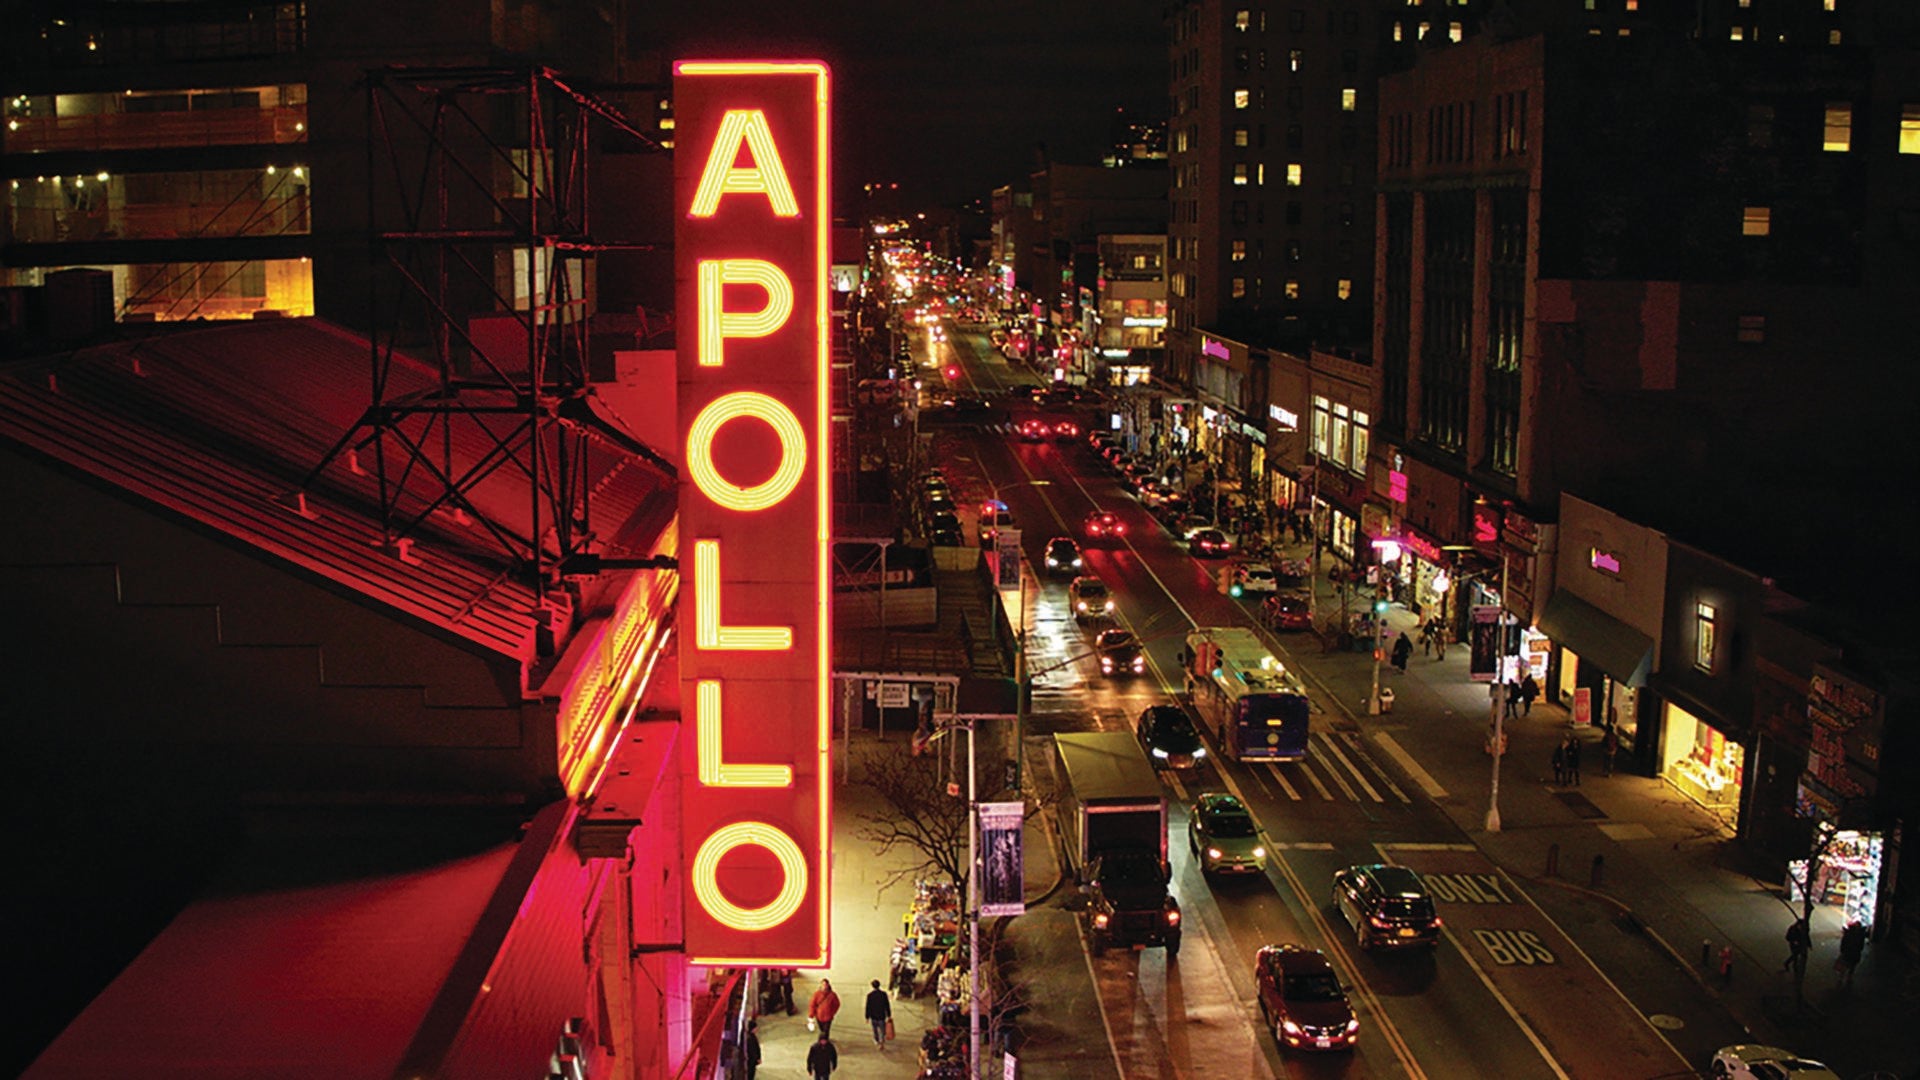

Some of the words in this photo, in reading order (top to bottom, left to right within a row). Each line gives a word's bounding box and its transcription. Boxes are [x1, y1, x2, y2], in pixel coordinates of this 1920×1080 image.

[686, 109, 808, 932] APOLLO
[1422, 874, 1513, 904] ONLY
[1472, 929, 1556, 966] BUS
